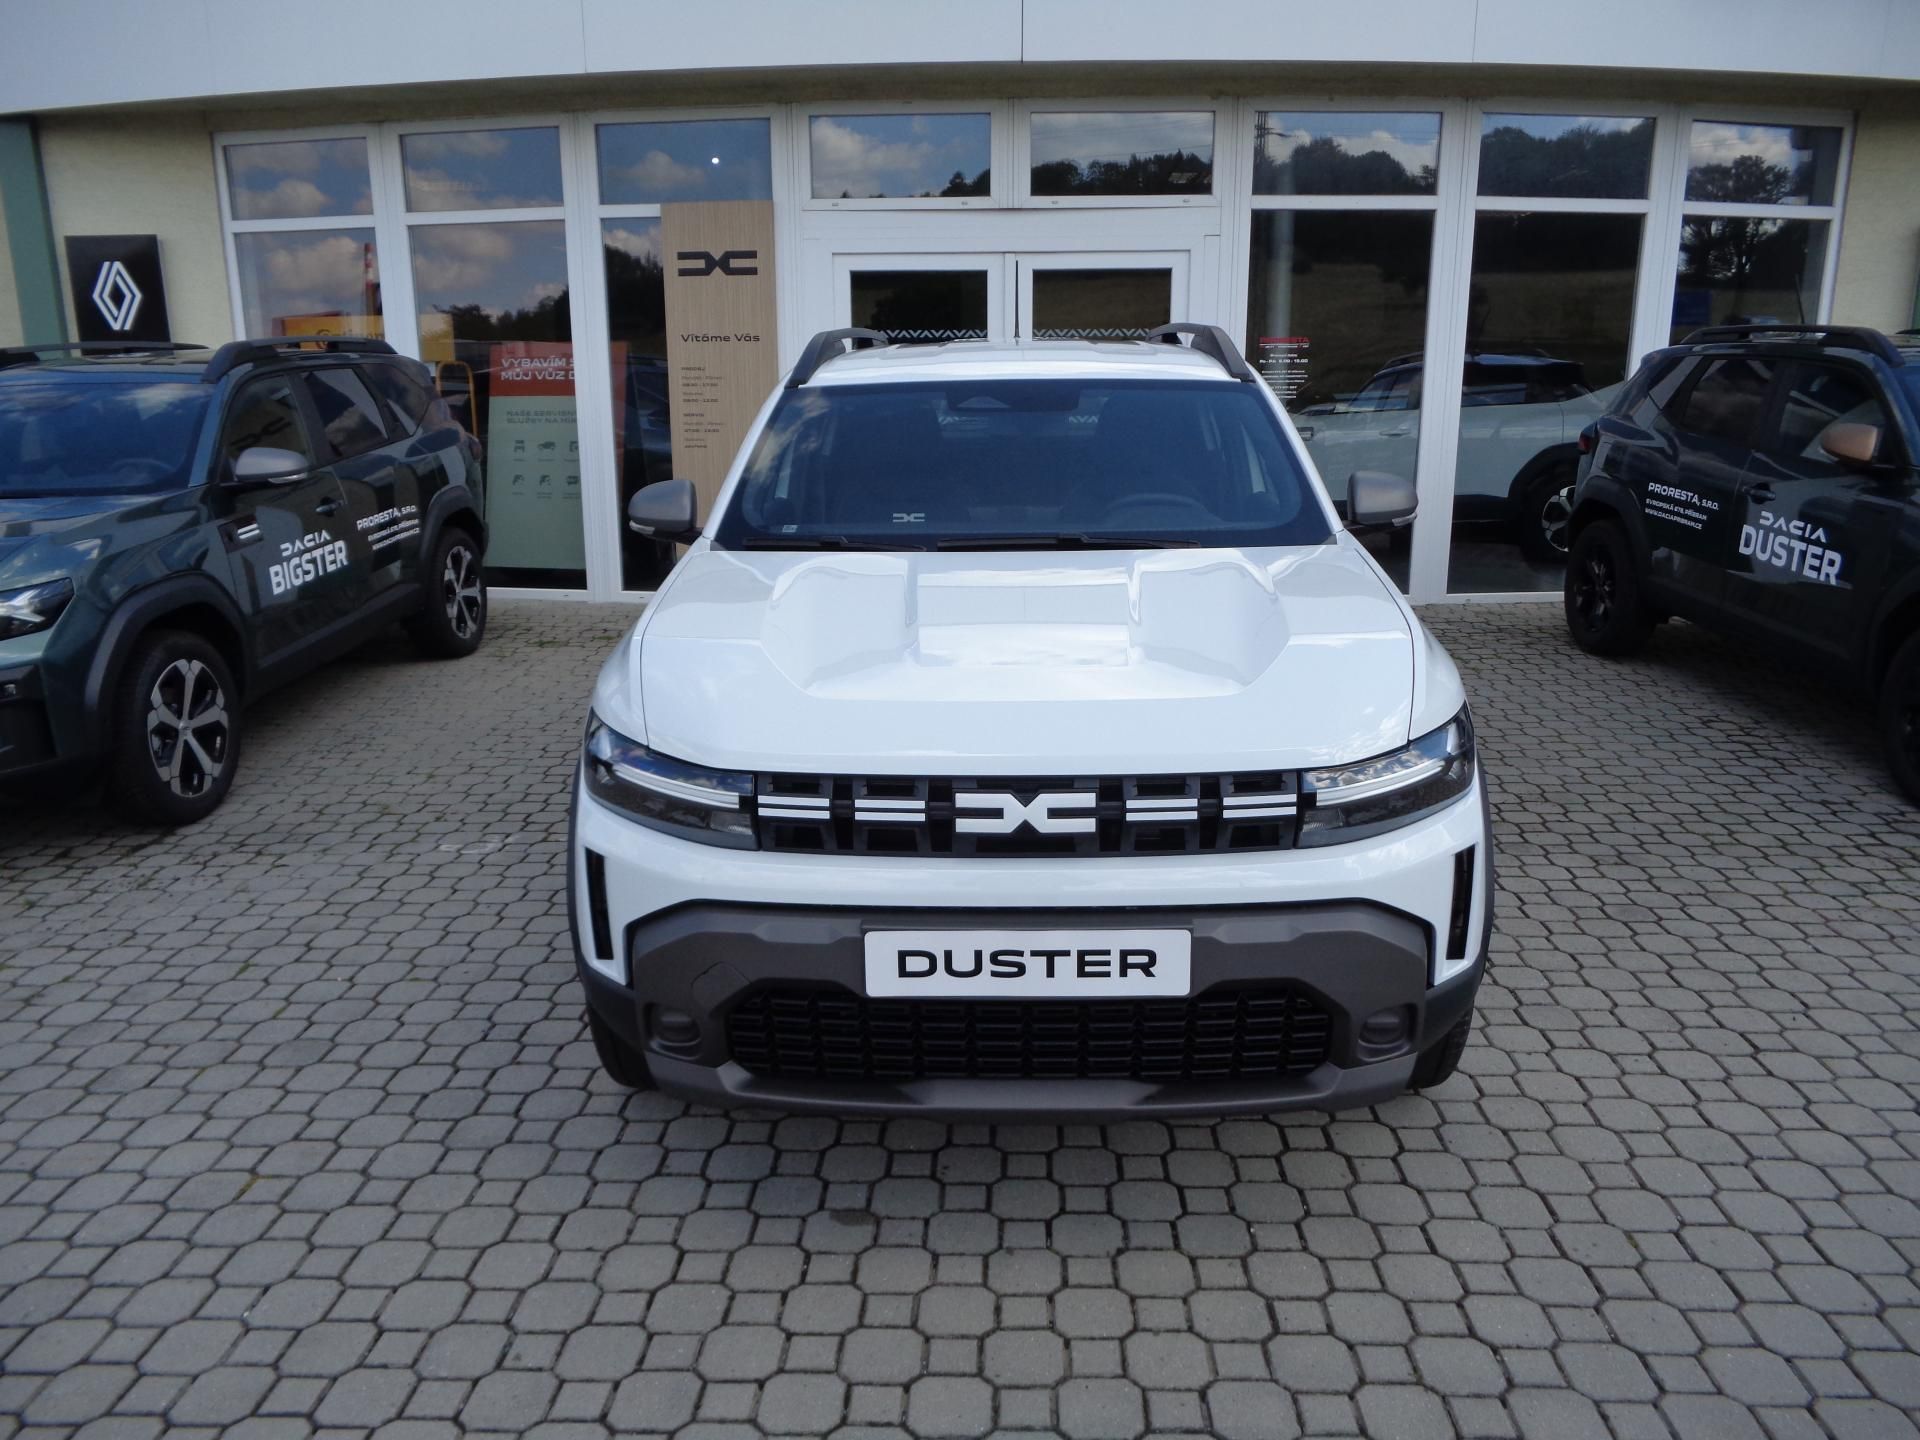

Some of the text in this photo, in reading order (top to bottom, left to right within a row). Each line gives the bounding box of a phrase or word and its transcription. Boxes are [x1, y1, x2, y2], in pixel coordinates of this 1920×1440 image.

[681, 333, 760, 342] Vítáme Vás
[501, 356, 567, 368] VYBAVÍM
[501, 368, 531, 381] MŮJ
[535, 368, 565, 380] VŮZ
[1648, 482, 1700, 506] PRORESTA,
[356, 507, 401, 532] PRORESTA,
[1759, 510, 1827, 543] DACIA
[280, 530, 332, 557] DACIA
[1739, 524, 1842, 586] DUSTER
[269, 540, 349, 596] BIGSTER
[897, 949, 1157, 978] DUSTER
